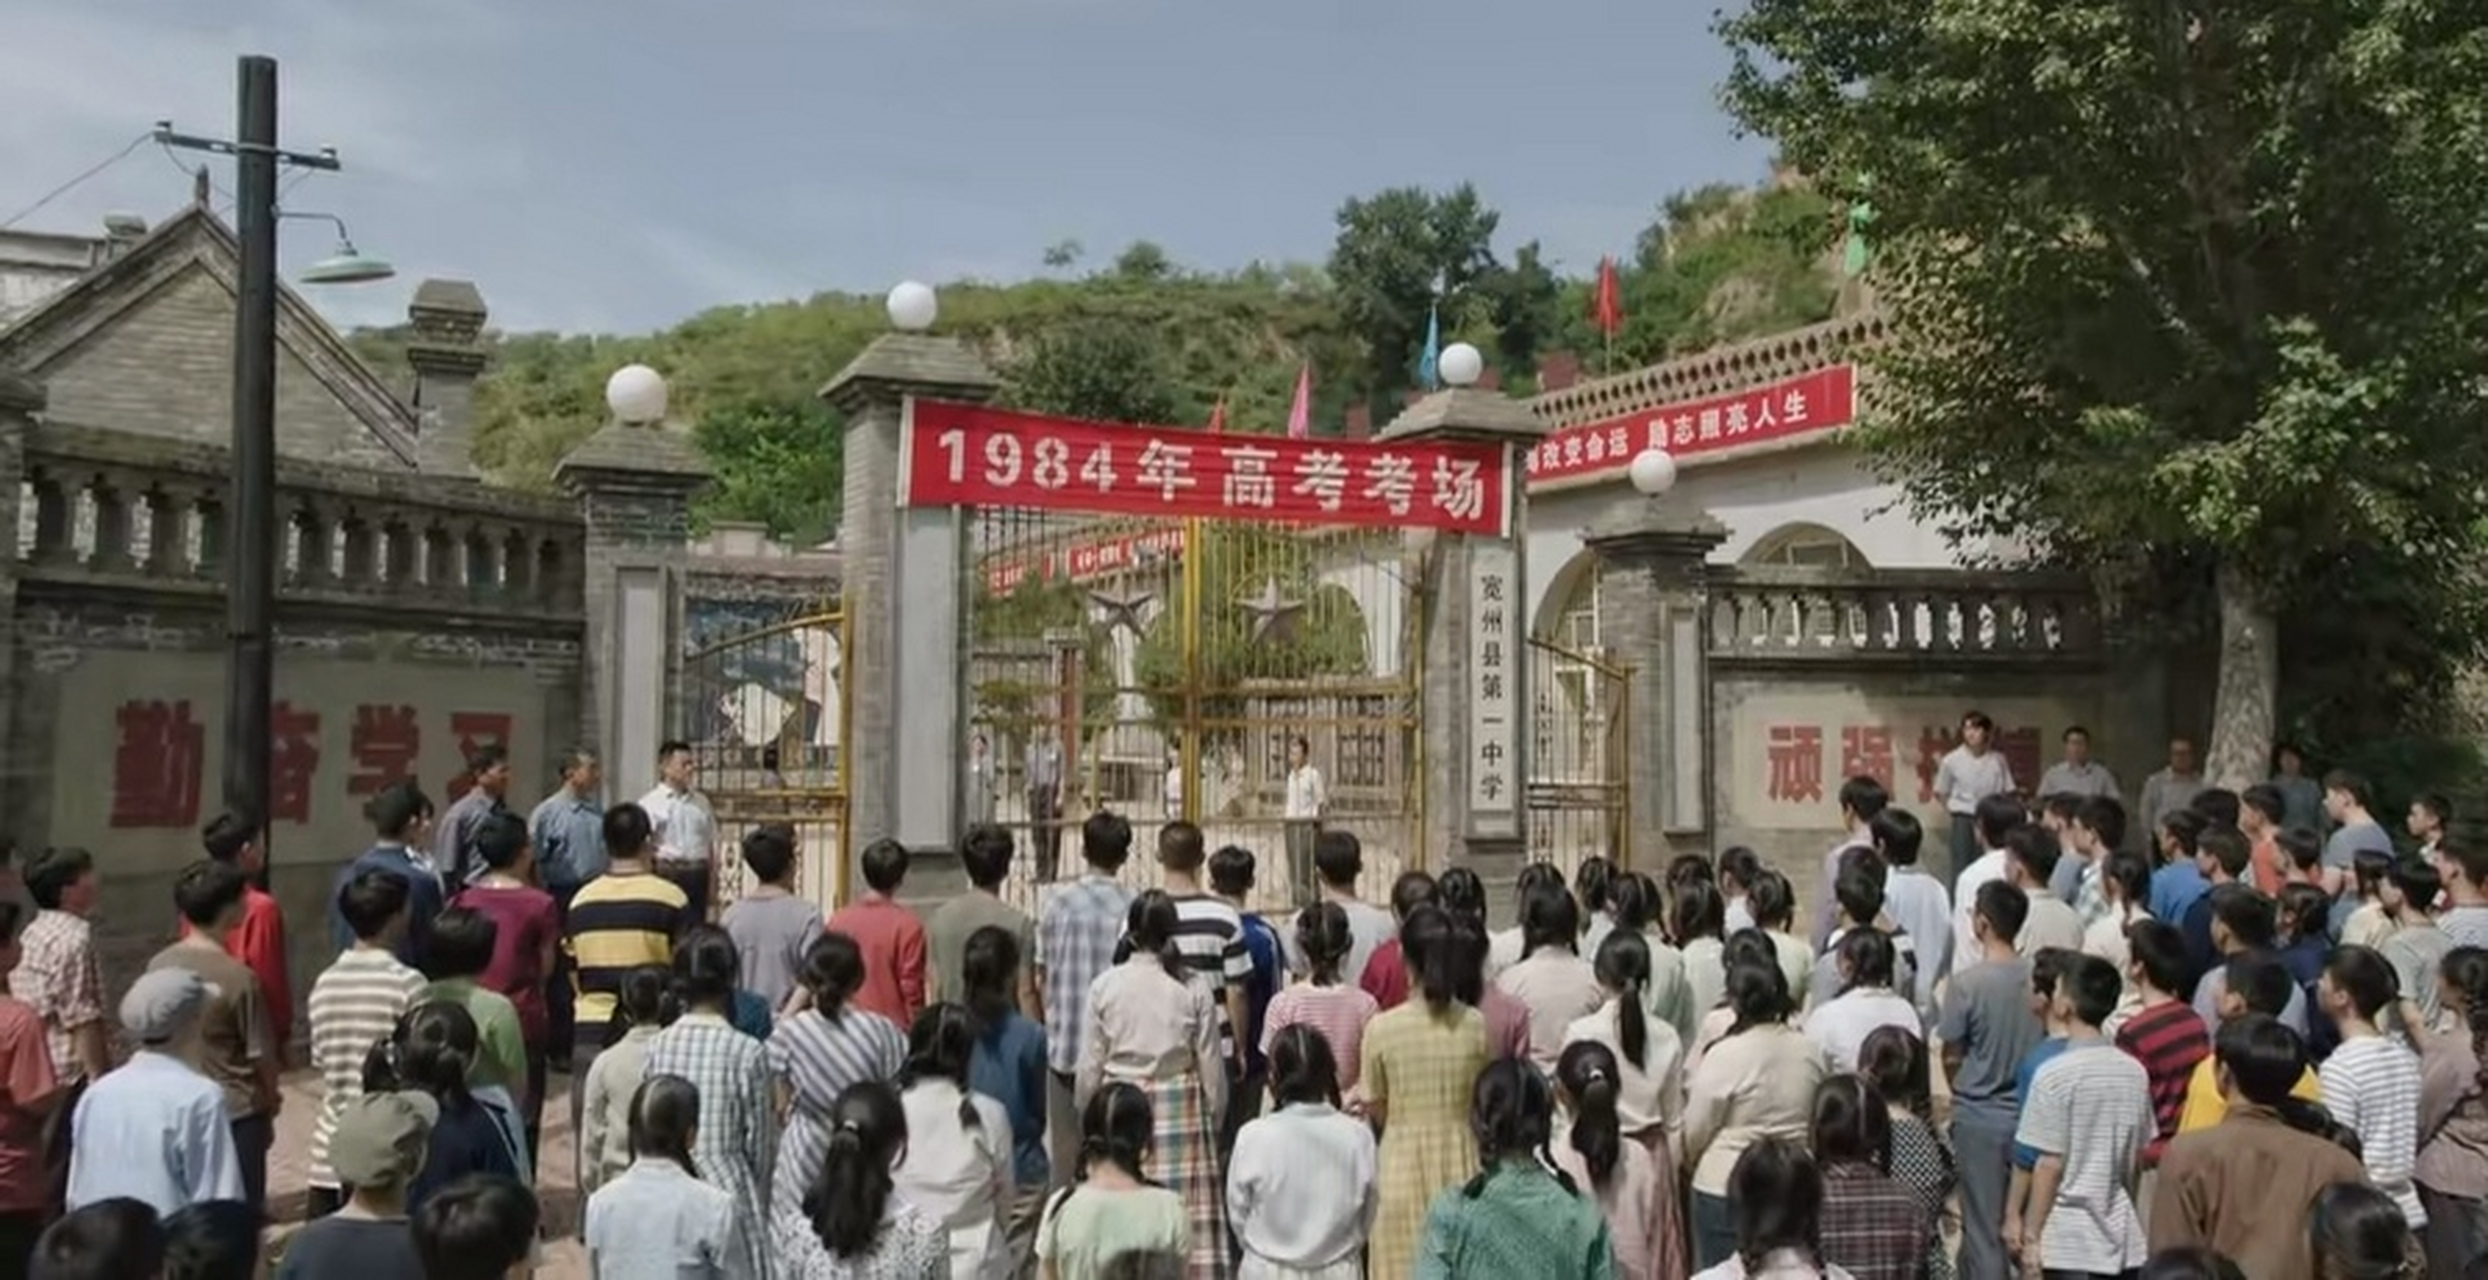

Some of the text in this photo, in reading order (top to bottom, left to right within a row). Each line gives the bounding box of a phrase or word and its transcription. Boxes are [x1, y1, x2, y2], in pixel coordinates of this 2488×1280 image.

[937, 427, 1484, 520] 1984年高考考场
[1481, 574, 1504, 801] 宽州县第一中学
